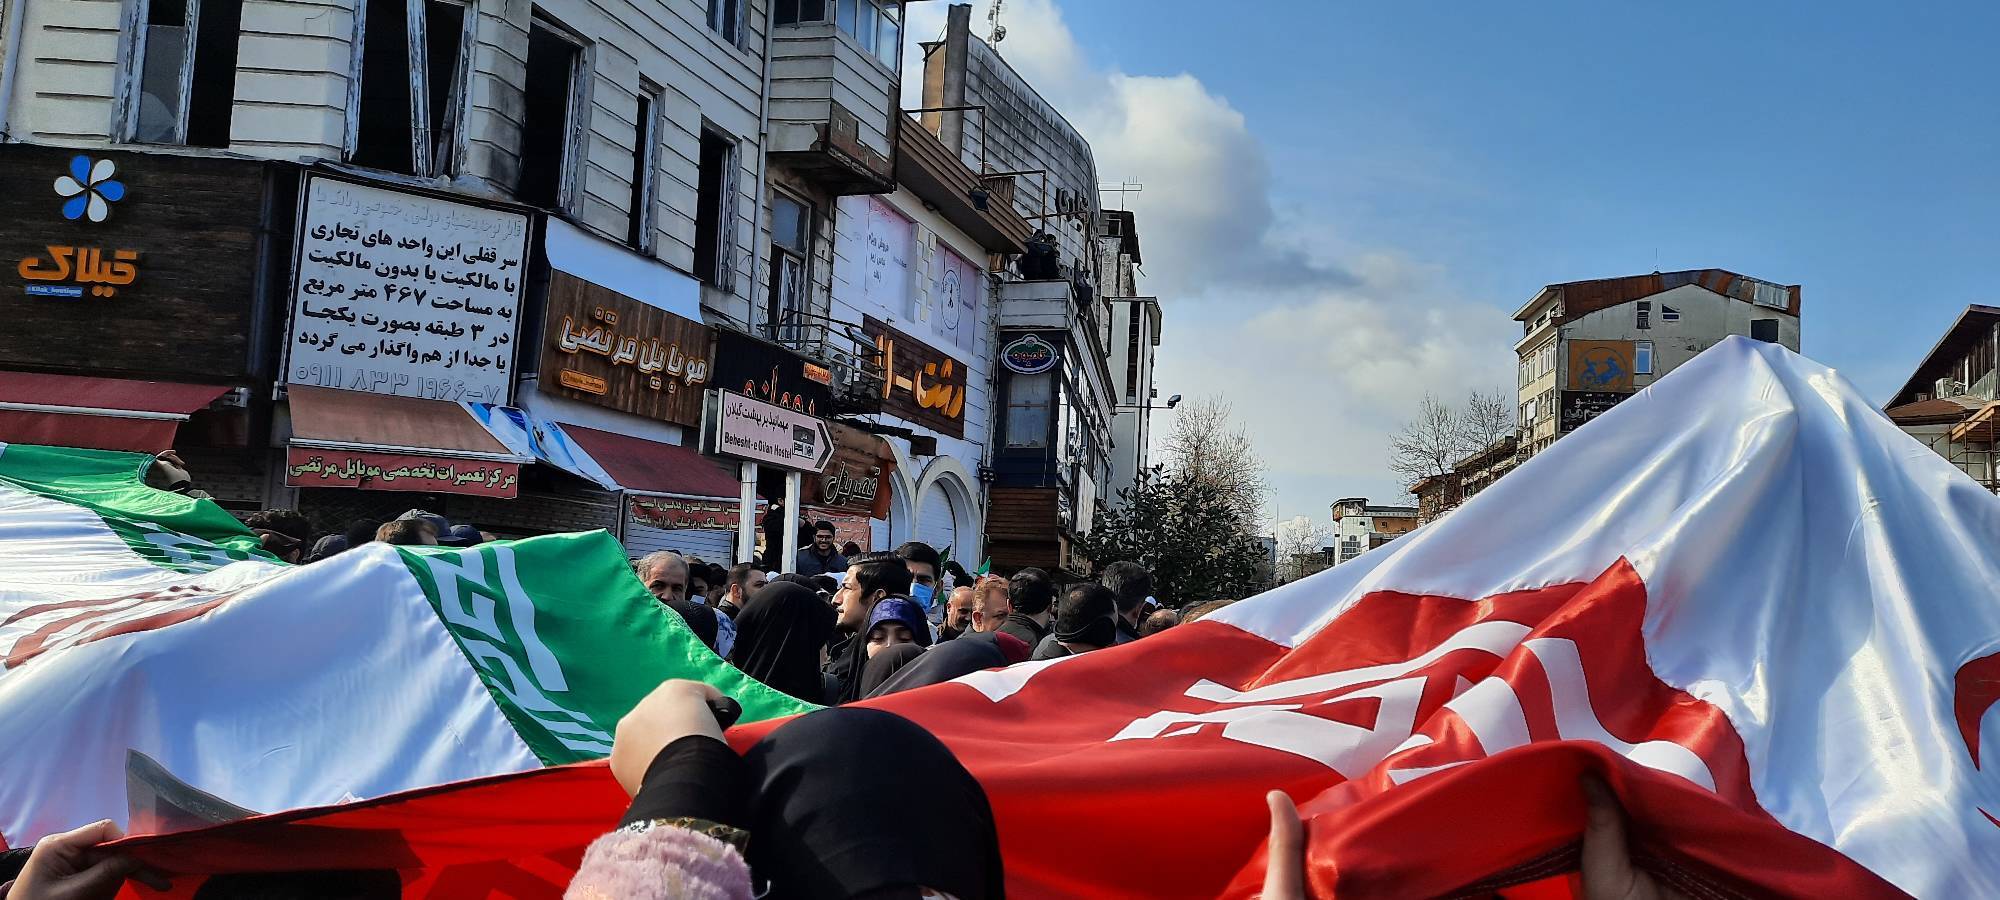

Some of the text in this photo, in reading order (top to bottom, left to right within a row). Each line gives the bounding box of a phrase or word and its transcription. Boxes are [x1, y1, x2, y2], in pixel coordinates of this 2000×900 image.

[310, 221, 518, 271] سر قفلی این واحد های تجاری
[307, 248, 516, 296] با مالکیت یا بدون مالکیت
[302, 277, 513, 323] به مساحت ۴۶۷ متر مربع
[360, 311, 421, 337] بصورت
[424, 319, 465, 340] طبقه
[470, 323, 485, 342] ۳
[558, 306, 638, 366] مرتضی
[298, 331, 507, 374] یا جدا از هم واگذار می گردد
[487, 331, 510, 348] در
[638, 338, 708, 394] موبایل
[725, 401, 789, 434] مهمانپذیر بهشت گیلان
[724, 431, 758, 451] Behesht-e
[757, 439, 774, 456] Gilan
[774, 443, 792, 460] Hostel
[289, 456, 338, 479] مرتضی
[337, 458, 381, 482] موبایل
[435, 464, 486, 486] تعمیرات
[485, 467, 517, 490] مرکز
